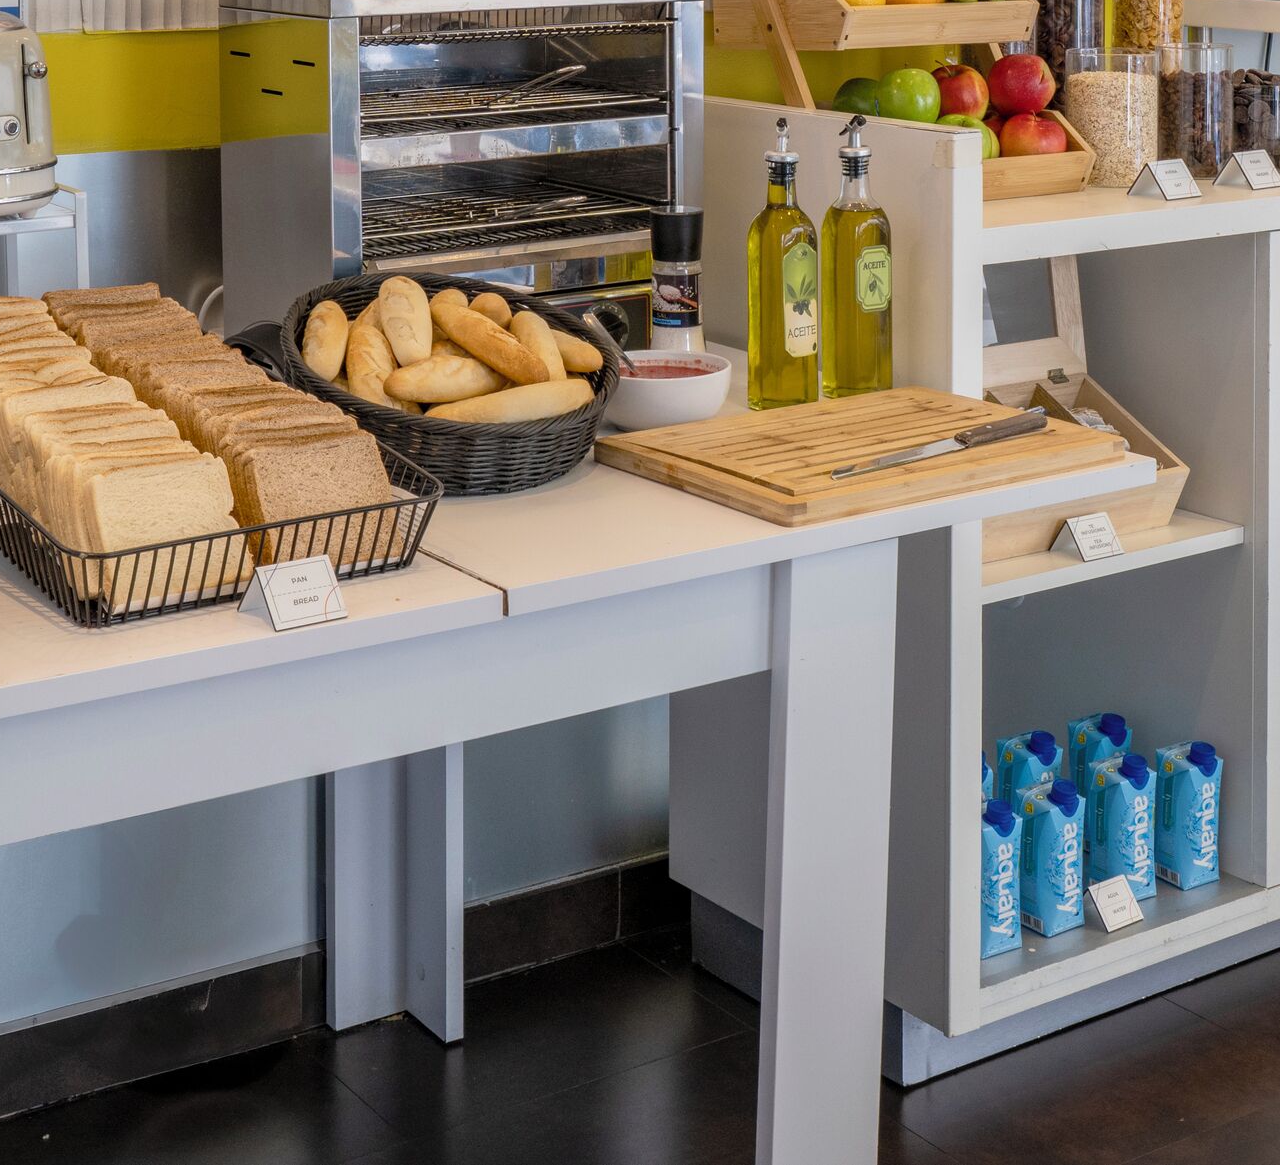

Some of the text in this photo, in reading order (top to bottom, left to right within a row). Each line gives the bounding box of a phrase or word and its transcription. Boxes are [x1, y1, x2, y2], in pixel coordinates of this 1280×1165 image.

[863, 260, 887, 270] ACEITE
[788, 325, 816, 339] ACEITE
[291, 576, 308, 584] PAN
[293, 595, 319, 606] BREAD
[1113, 906, 1127, 915] WATER
